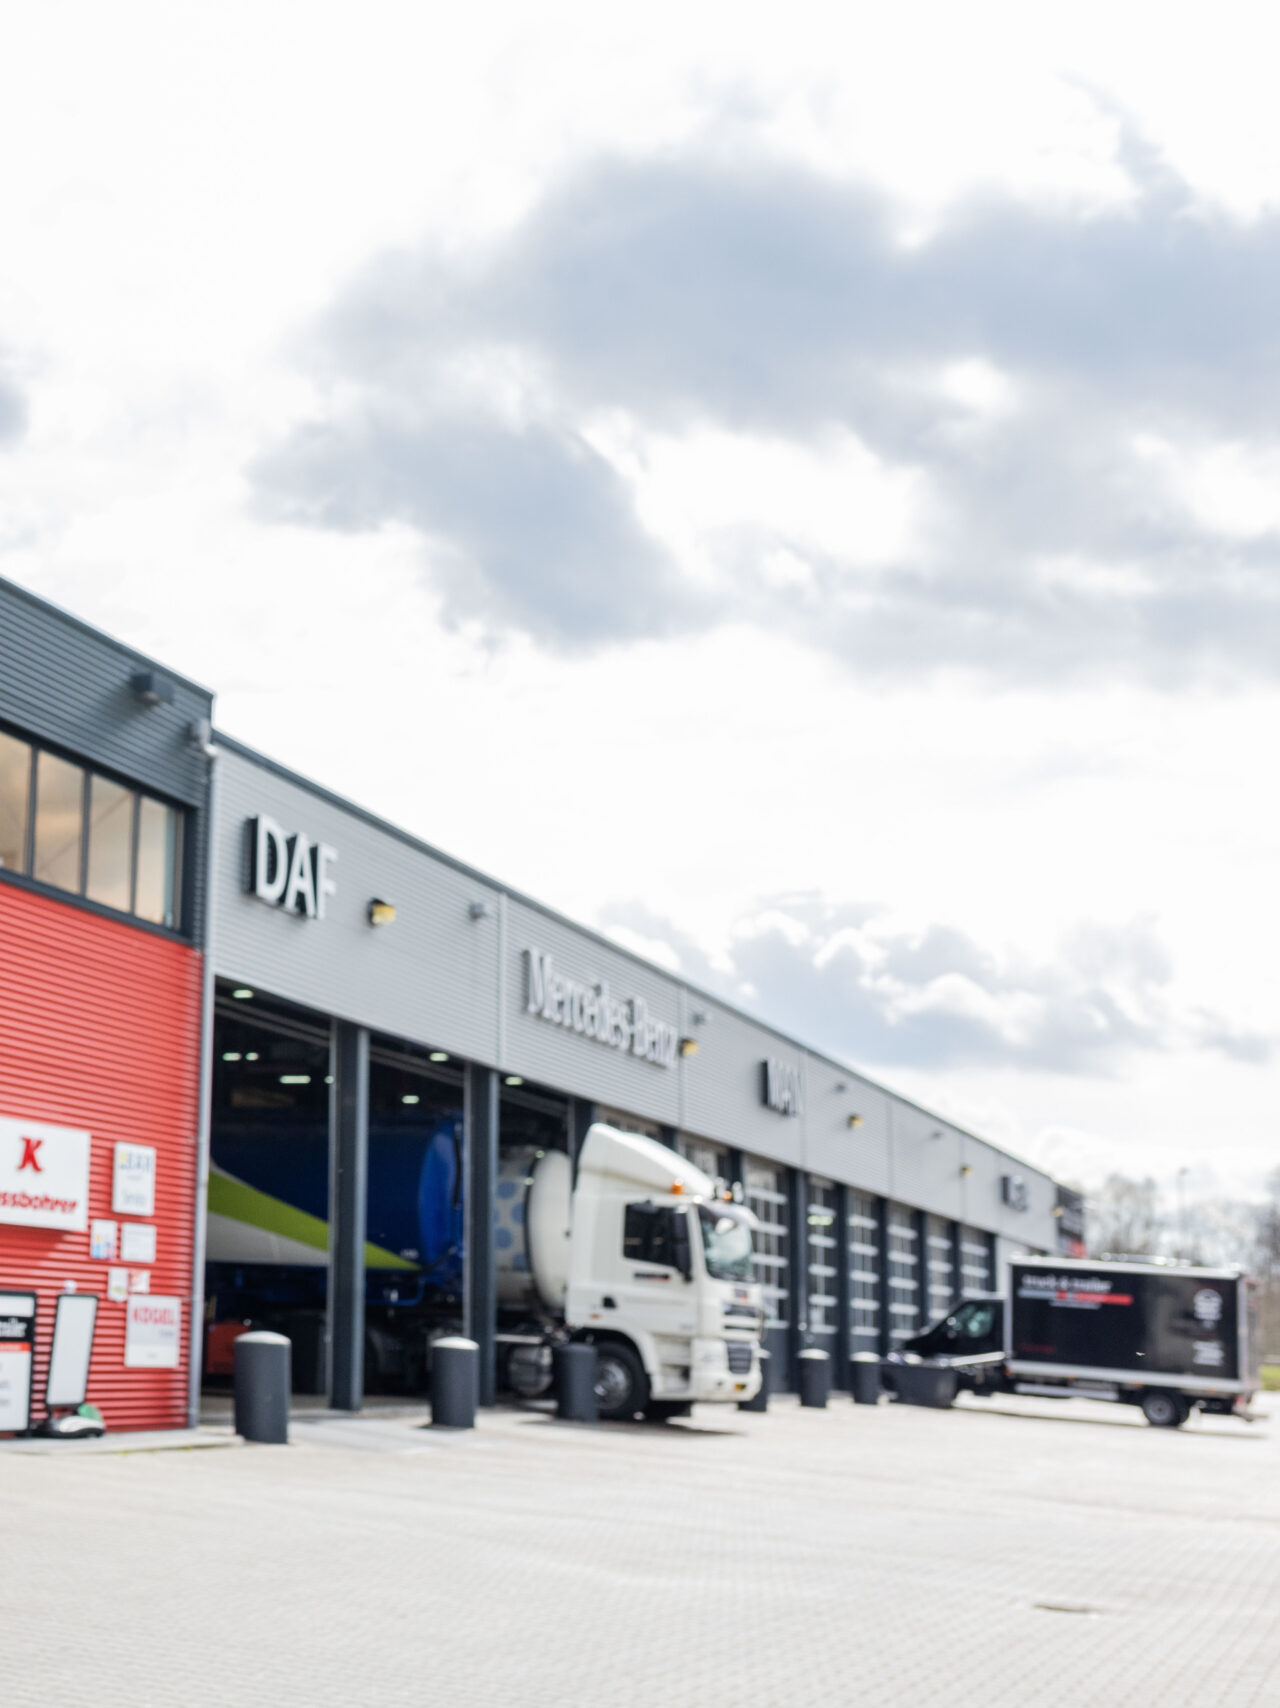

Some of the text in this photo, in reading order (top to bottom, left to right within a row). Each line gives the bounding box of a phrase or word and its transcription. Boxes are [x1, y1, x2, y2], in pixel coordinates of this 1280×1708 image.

[254, 813, 339, 920] DAF
[525, 947, 677, 1070] Mercedes-Benz
[18, 1136, 43, 1172] K
